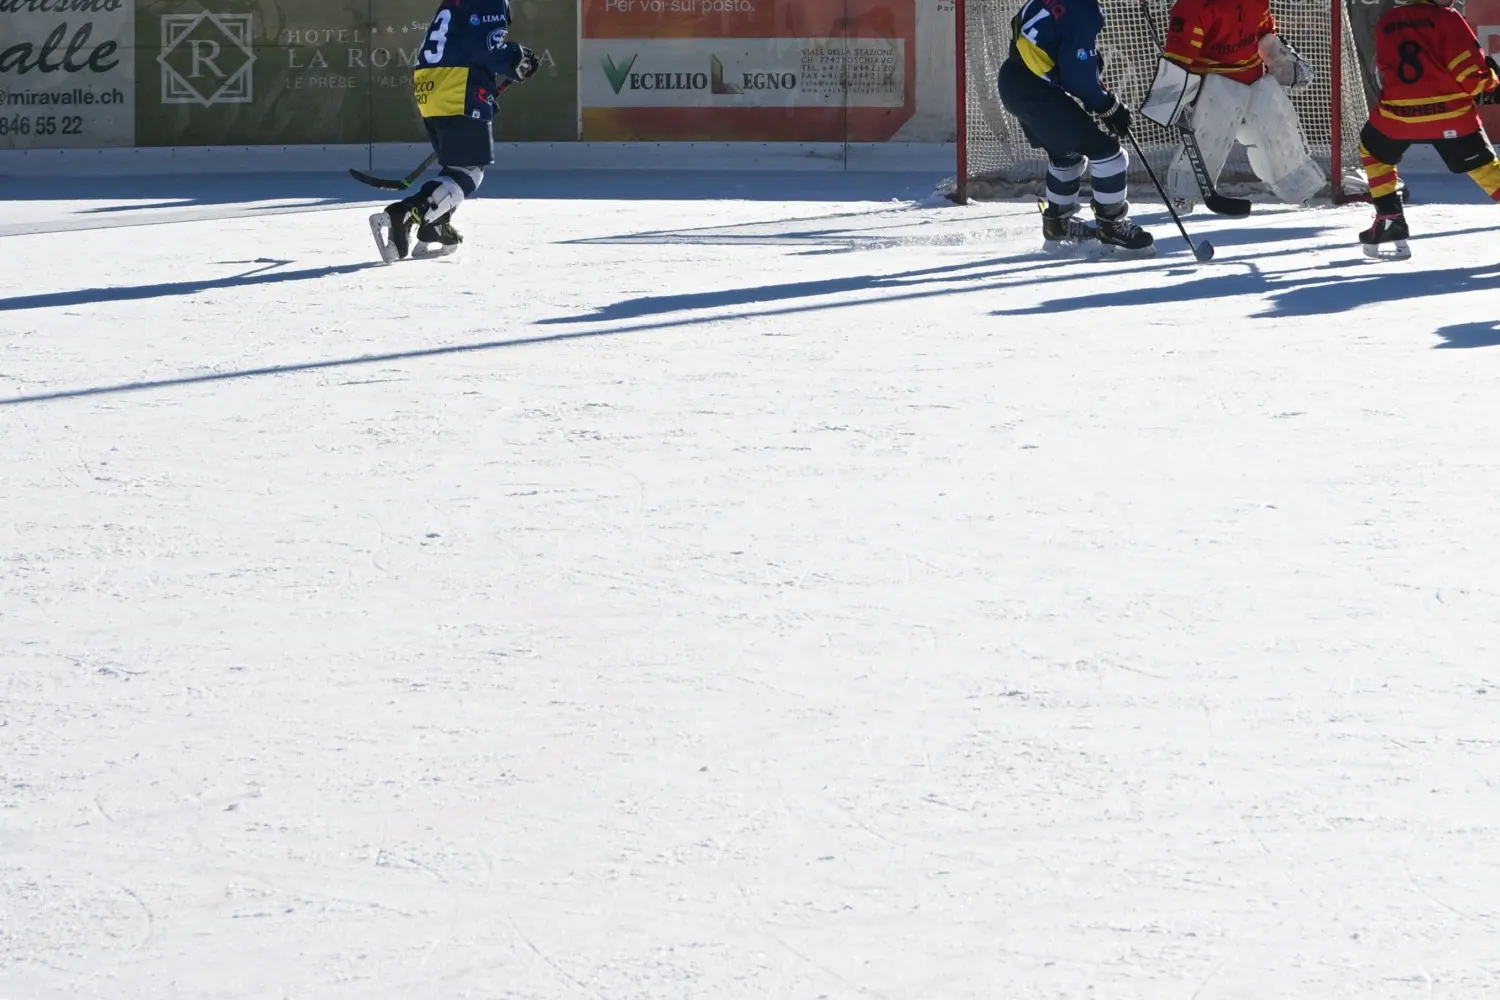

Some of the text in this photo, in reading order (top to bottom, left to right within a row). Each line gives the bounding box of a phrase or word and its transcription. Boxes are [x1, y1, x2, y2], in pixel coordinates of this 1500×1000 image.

[287, 29, 365, 43] HOTEL
[287, 48, 329, 68] LA
[801, 48, 824, 56] VIALE
[827, 48, 852, 56] DELLA
[1398, 40, 1424, 84] 8
[286, 77, 303, 89] LE
[309, 76, 357, 89] PRESE
[601, 53, 708, 95] VECELLIO
[710, 53, 797, 95] LEGNO
[0, 115, 83, 136] 846 55 22
